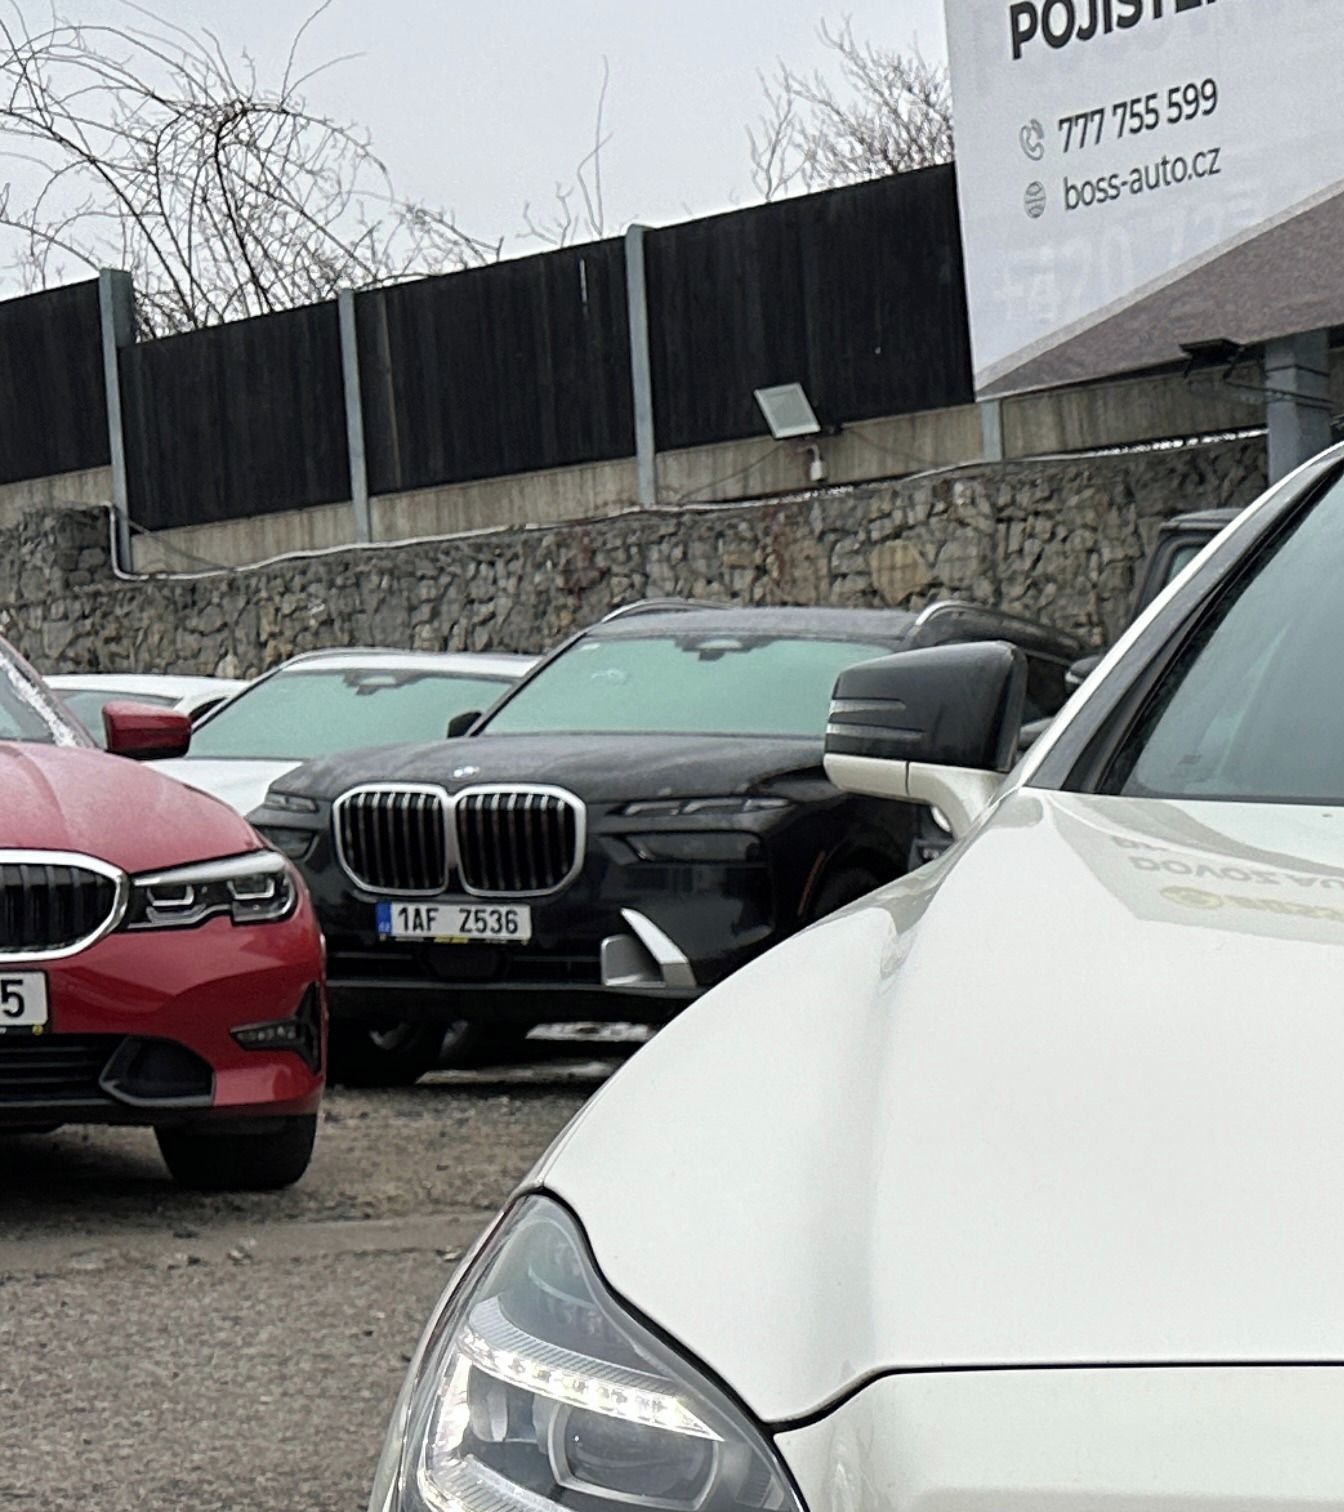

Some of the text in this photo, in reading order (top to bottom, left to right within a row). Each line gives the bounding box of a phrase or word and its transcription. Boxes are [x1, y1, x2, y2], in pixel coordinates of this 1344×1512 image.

[1058, 78, 1218, 153] 777 755 599
[1063, 147, 1221, 210] boss-auto.cz
[398, 906, 519, 935] 1AF Z536
[0, 979, 25, 1018] 5
